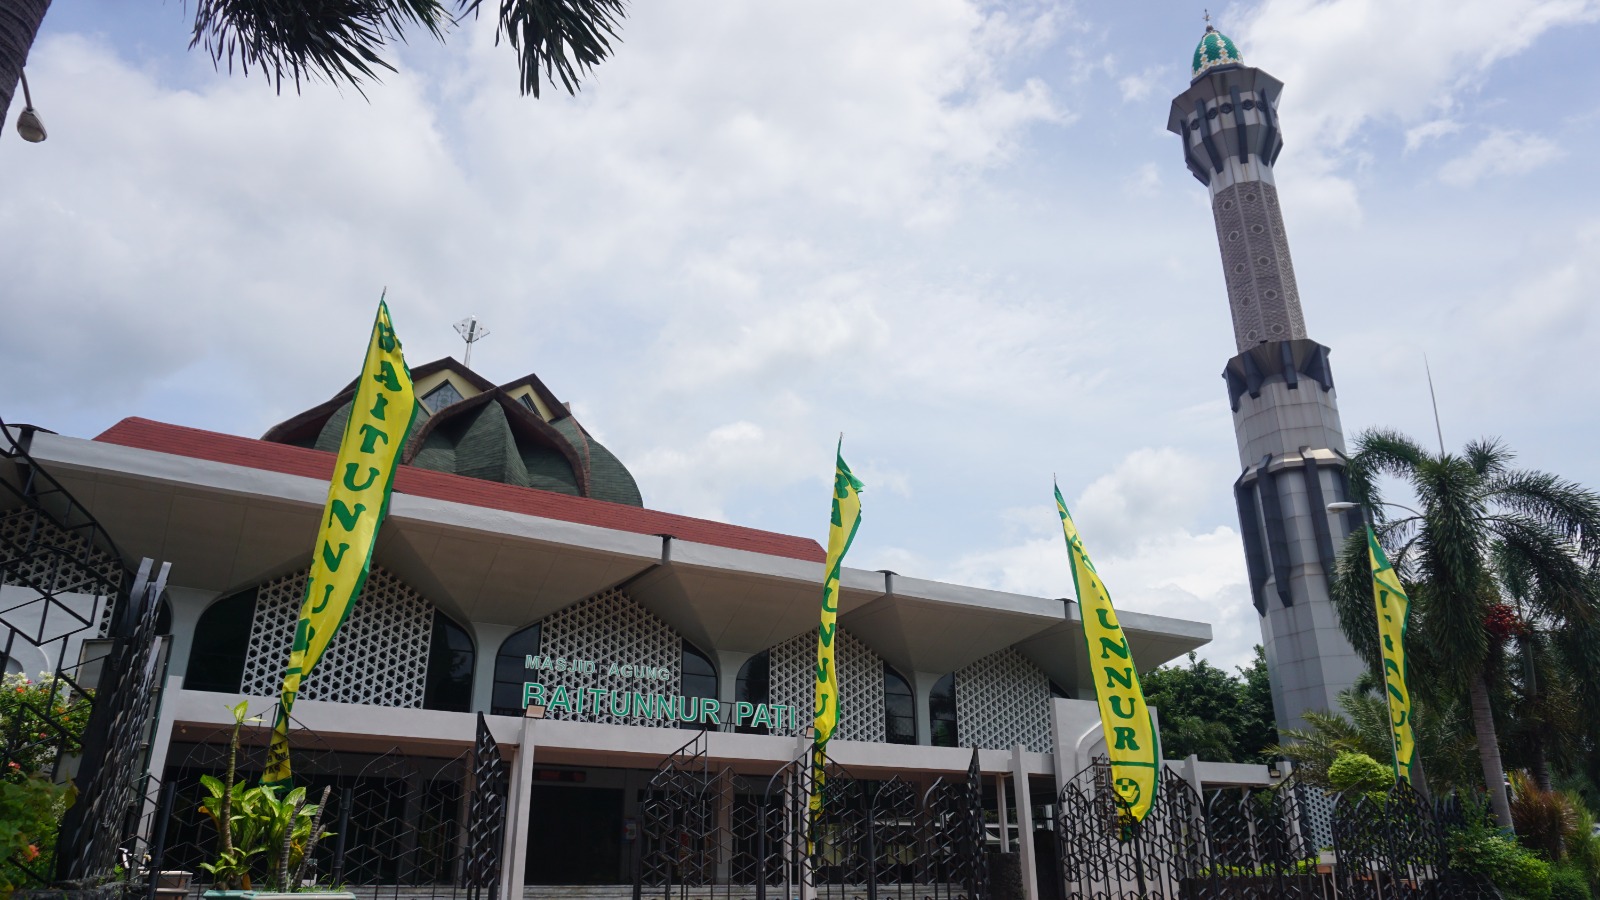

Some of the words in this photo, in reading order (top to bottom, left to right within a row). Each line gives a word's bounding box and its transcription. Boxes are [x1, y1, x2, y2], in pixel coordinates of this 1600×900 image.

[525, 654, 596, 675] MASJID
[607, 662, 670, 681] AGUNG
[522, 681, 720, 725] BAITUNNUR
[734, 701, 796, 730] PATI
